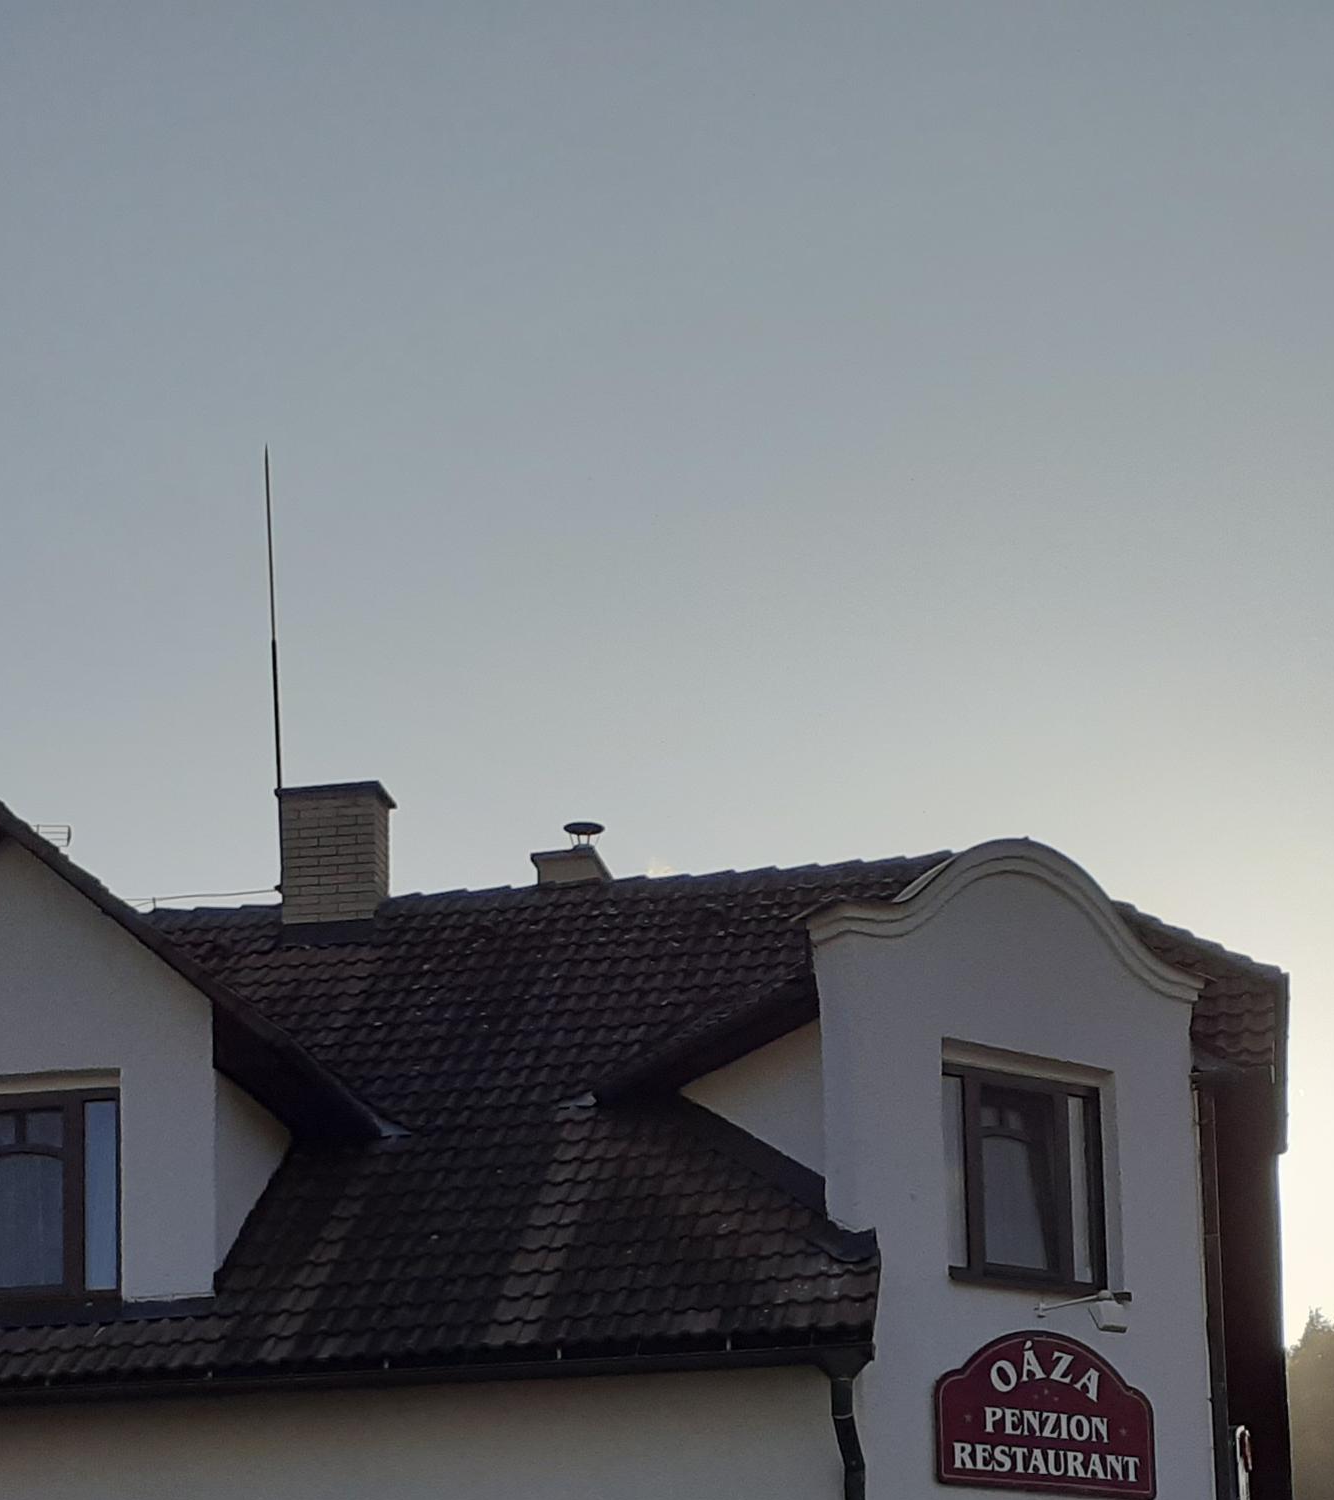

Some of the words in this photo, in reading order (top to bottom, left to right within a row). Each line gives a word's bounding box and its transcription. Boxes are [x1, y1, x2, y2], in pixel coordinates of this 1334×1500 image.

[990, 1340, 1100, 1402] OÁZA
[984, 1407, 1108, 1442] PENZION
[953, 1443, 1139, 1481] RESTAURANT
